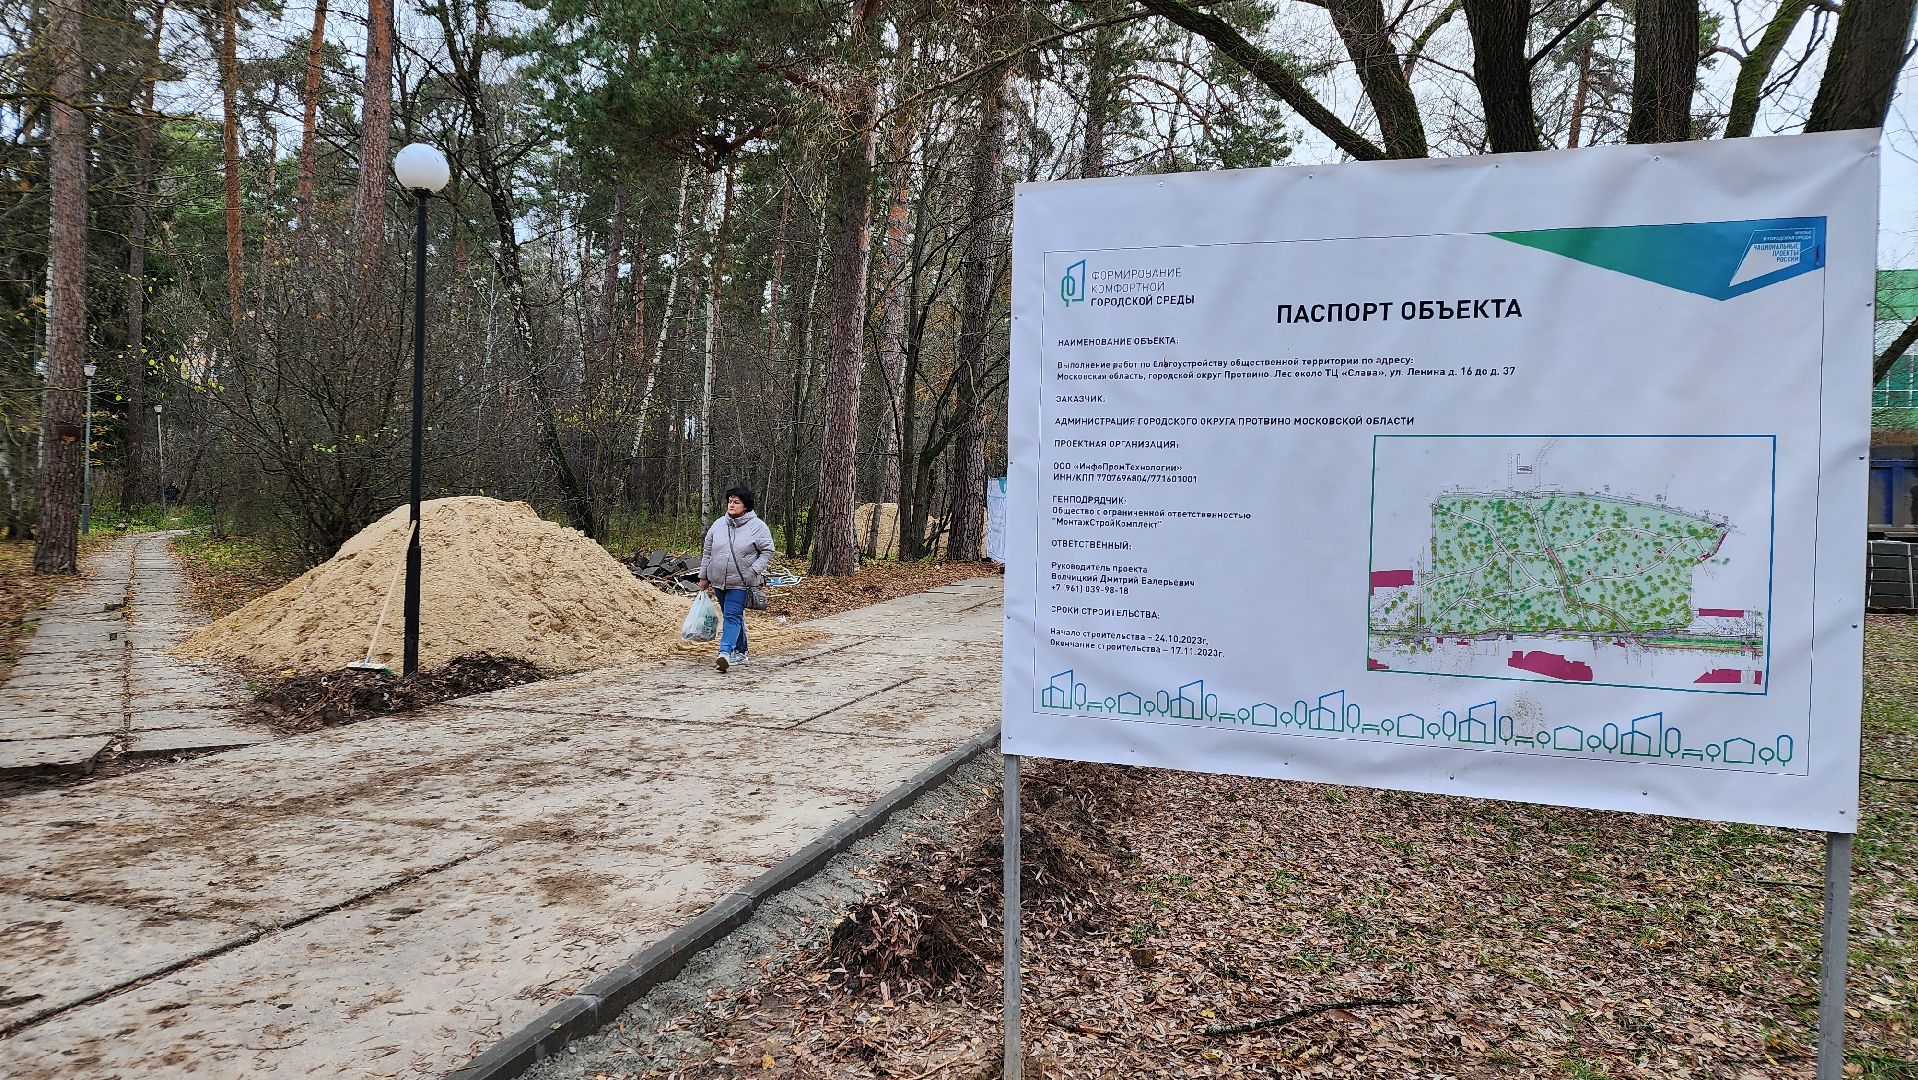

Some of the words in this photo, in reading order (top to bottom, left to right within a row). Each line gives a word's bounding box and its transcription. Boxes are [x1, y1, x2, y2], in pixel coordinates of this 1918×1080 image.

[1753, 243, 1799, 251] НАЦИОНАЛЬНЫЕ
[1091, 267, 1182, 281] ФОРМИРОВАНИЕ
[1091, 280, 1165, 294] КОМФОРТНОЙ
[1090, 293, 1153, 308] ГОРОДСКОЙ
[1156, 294, 1195, 306] СРЕДЫ
[1277, 301, 1394, 324] ПАСПОРТ
[1401, 298, 1523, 321] ОБЪЕКТА
[1057, 337, 1133, 347] НАИМЕНОВАНИЕ
[1133, 336, 1179, 346] ОБЪЕКТА:
[1057, 361, 1111, 370] Выполнение
[1112, 360, 1138, 371] работ
[1153, 357, 1228, 370] благоустройству
[1230, 358, 1299, 368] общественной
[1301, 358, 1359, 368] территории
[1361, 357, 1374, 365] по
[1375, 357, 1414, 366] адресу:
[1056, 372, 1107, 381] Московская
[1108, 371, 1146, 381] область,
[1148, 370, 1194, 382] городской
[1196, 371, 1223, 381] округ
[1273, 369, 1293, 378] Лес
[1294, 370, 1323, 378] около
[1324, 368, 1339, 379] ТЦ
[1341, 368, 1387, 378] «Слава»,
[1389, 369, 1404, 378] ул.
[1406, 367, 1446, 376] Ленина
[1447, 369, 1458, 377] д.
[1460, 366, 1473, 376] 16
[1474, 368, 1488, 377] до
[1489, 368, 1500, 377] д.
[1502, 366, 1516, 376] 37
[1055, 394, 1106, 403] ЗАКАЗЧИК:
[1054, 417, 1136, 427] АДМИНИСТРАЦИЯ
[1137, 417, 1198, 427] ГОРОДСКОГО
[1200, 417, 1236, 426] ОКРУГА
[1238, 417, 1291, 426] ПРОТВИНО
[1293, 415, 1363, 426] МОСКОВСКОЙ
[1365, 416, 1415, 426] ОБЛАСТИ
[1054, 439, 1107, 448] ПРОЕКТНАЯ
[1109, 440, 1179, 450] ОРГАНИЗАЦИЯ:
[1073, 462, 1183, 473] «ИнфоПромТехнологии»
[1053, 472, 1095, 482] ИНН/КПП
[1052, 495, 1127, 506] ГЕНПОДРЯДЧИК:
[1052, 506, 1095, 516] Общество
[1102, 509, 1165, 518] ограниченной
[1167, 511, 1252, 520] ответственностью
[1051, 517, 1162, 529] "МонтажСтройКомплект"
[1051, 539, 1132, 551] ОТВЕТСТВЕННЫЙ:
[1051, 561, 1111, 572] Руководитель
[1112, 565, 1148, 574] проекта
[1051, 572, 1098, 583] Волчицкий
[1099, 574, 1139, 586] Дмитрий
[1141, 576, 1195, 588] Валерьевич
[1051, 583, 1061, 592] +7
[1085, 585, 1129, 595] 039-98-18
[1051, 605, 1079, 615] СРОКИ
[1081, 607, 1160, 620] СТРОИТЕЛЬСТВА:
[1050, 627, 1081, 637] Начало
[1082, 631, 1146, 641] строительства
[1050, 637, 1096, 649] Окончание
[1097, 643, 1161, 654] строительства
